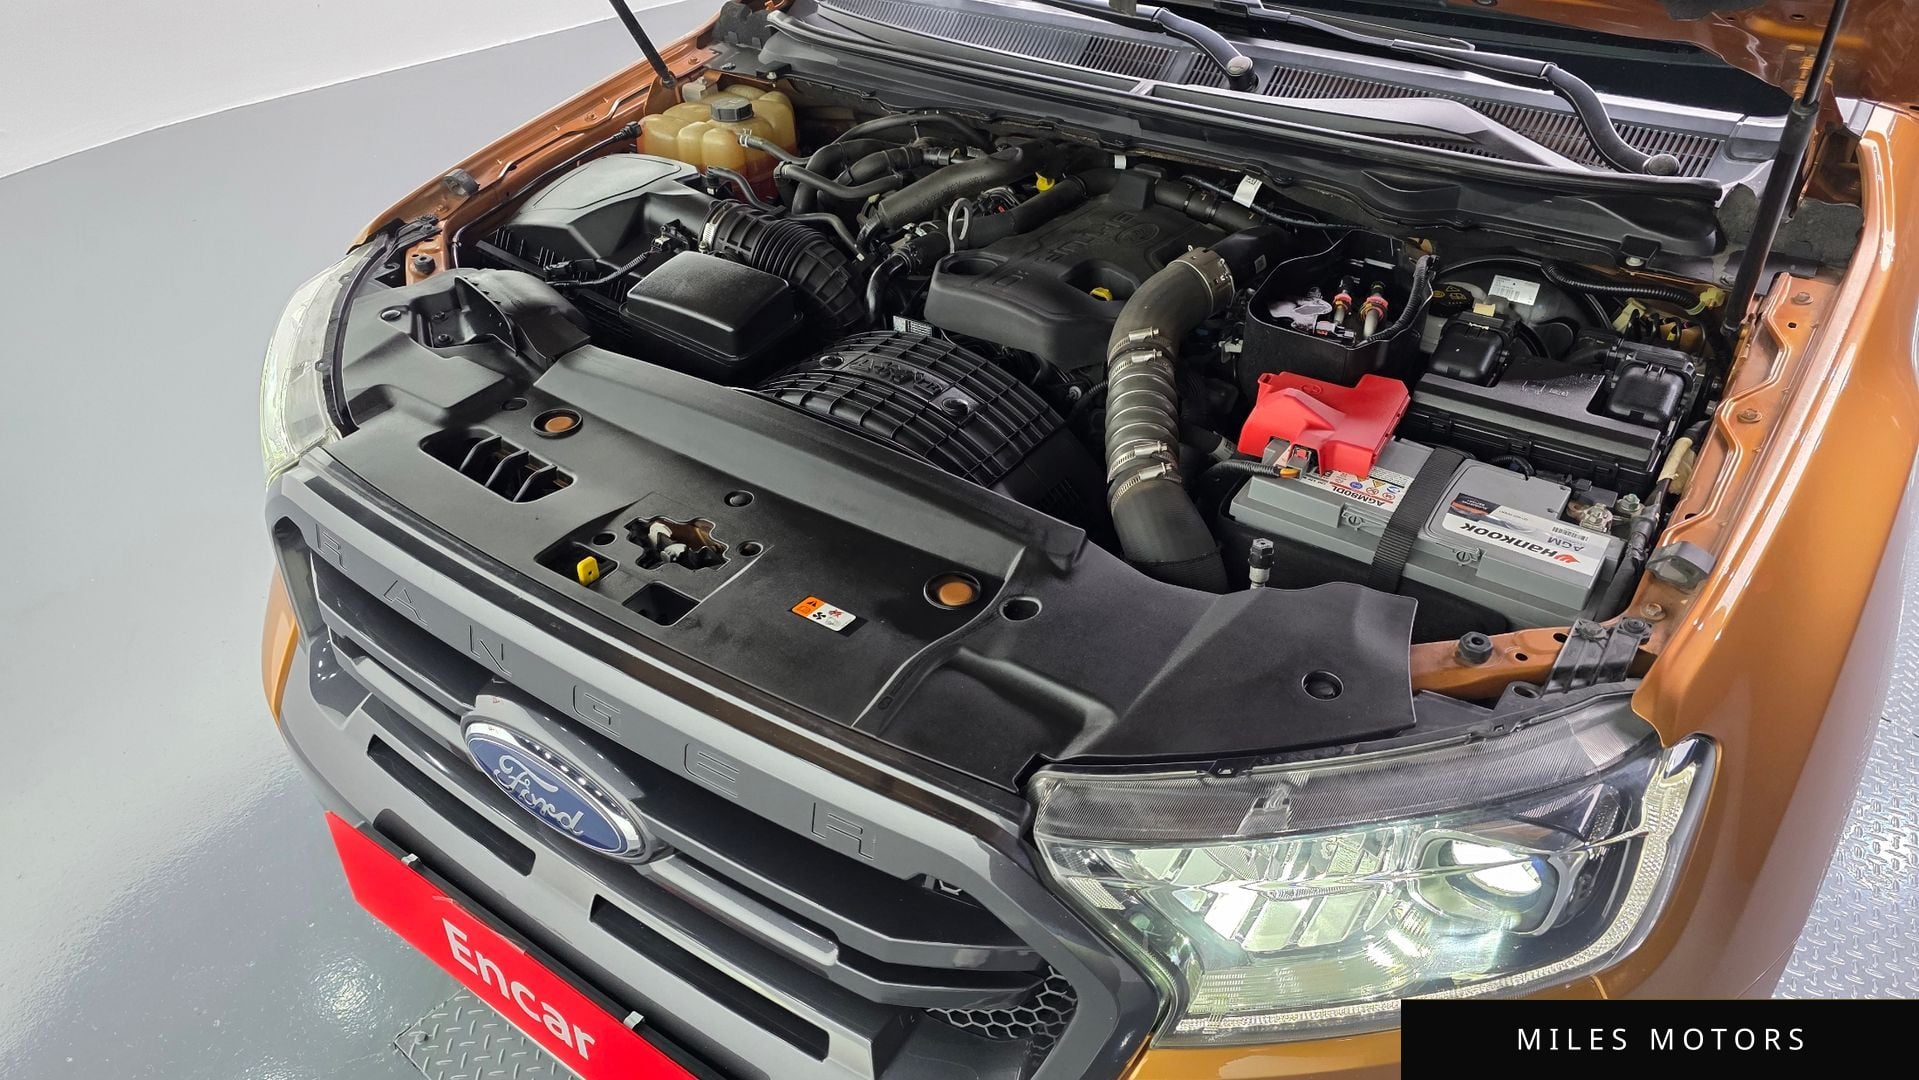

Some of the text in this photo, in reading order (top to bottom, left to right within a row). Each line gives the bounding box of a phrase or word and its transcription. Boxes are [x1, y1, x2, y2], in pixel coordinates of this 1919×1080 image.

[1332, 485, 1386, 507] AGM80DL
[1548, 536, 1585, 552] AGM
[316, 523, 877, 860] RANGER
[494, 754, 584, 835] Ford
[442, 917, 595, 1060] Encar
